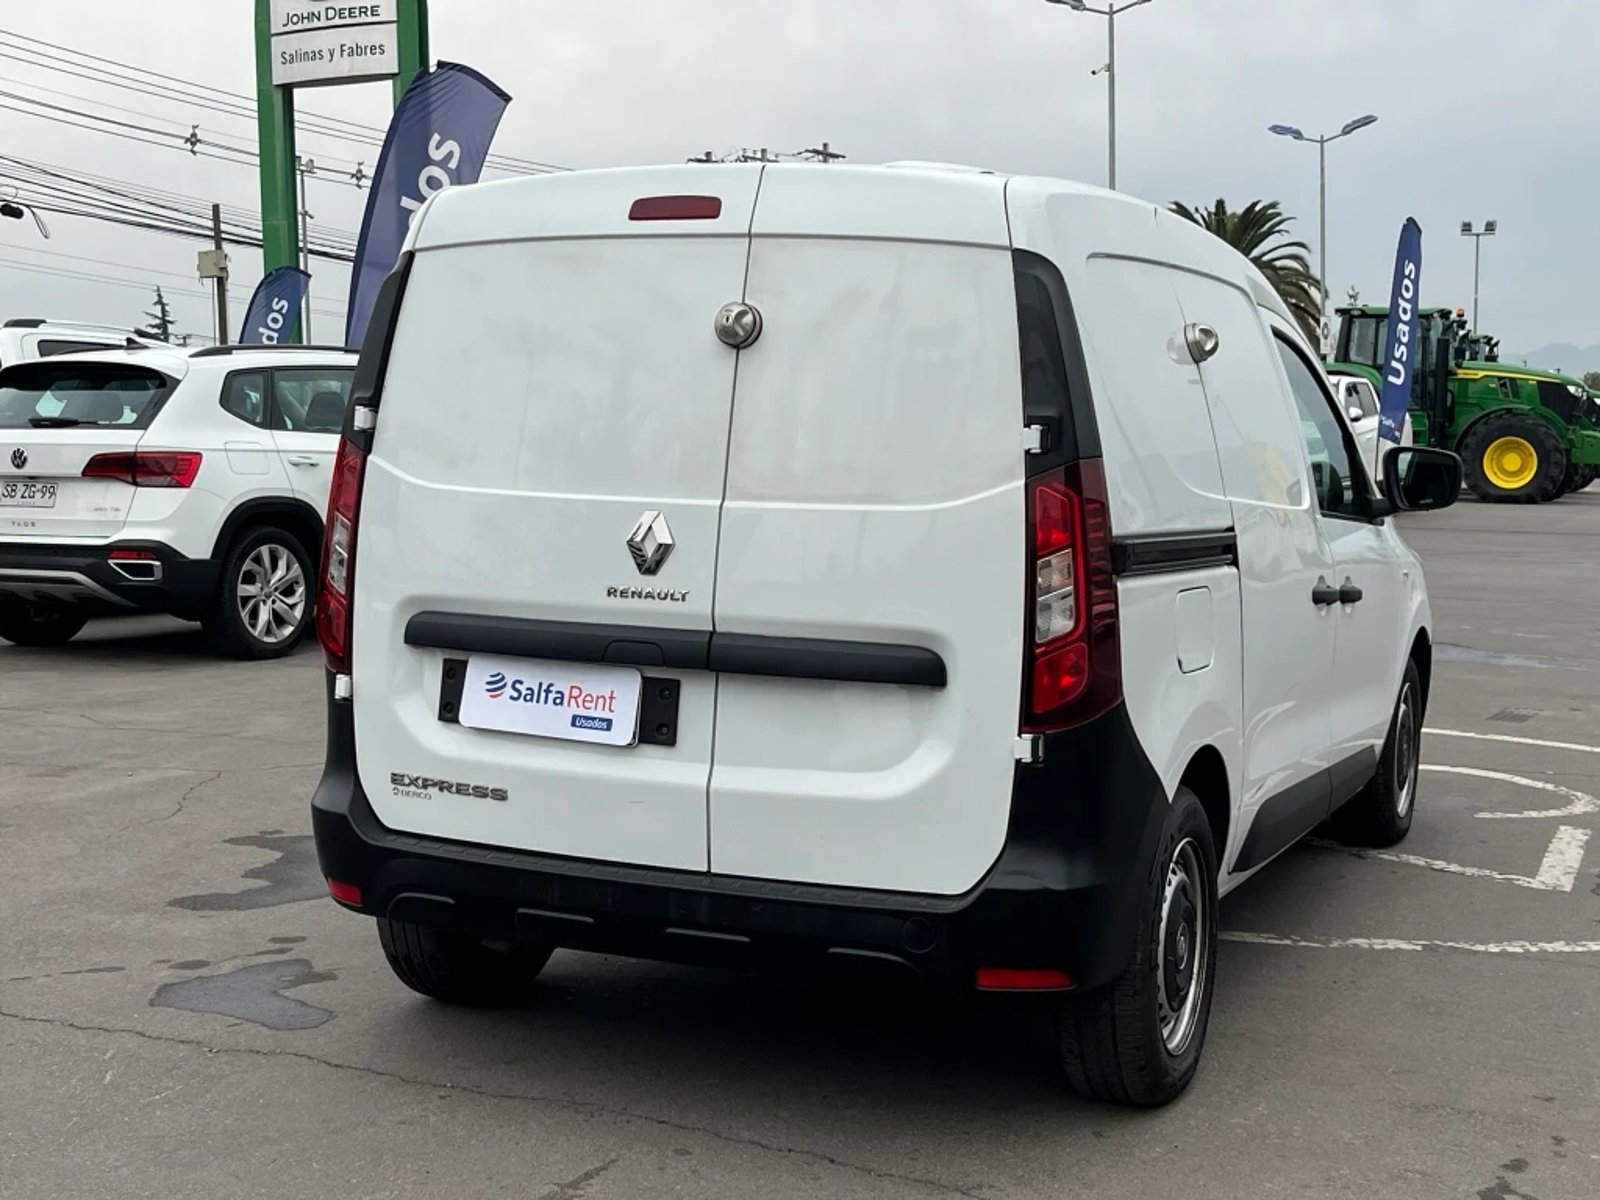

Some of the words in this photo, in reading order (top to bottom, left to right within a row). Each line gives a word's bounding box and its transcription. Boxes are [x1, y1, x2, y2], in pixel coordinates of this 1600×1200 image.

[282, 10, 321, 27] JOHN
[325, 5, 381, 21] DEERE
[280, 47, 324, 65] Salinas
[328, 48, 336, 62] y
[340, 43, 386, 58] Fabres
[1387, 259, 1416, 386] Usados
[606, 585, 690, 603] RENAULT
[508, 679, 617, 713] SalfaRent
[575, 716, 608, 730] Usados
[390, 771, 509, 802] EXPRESS
[401, 789, 432, 800] DERCO
